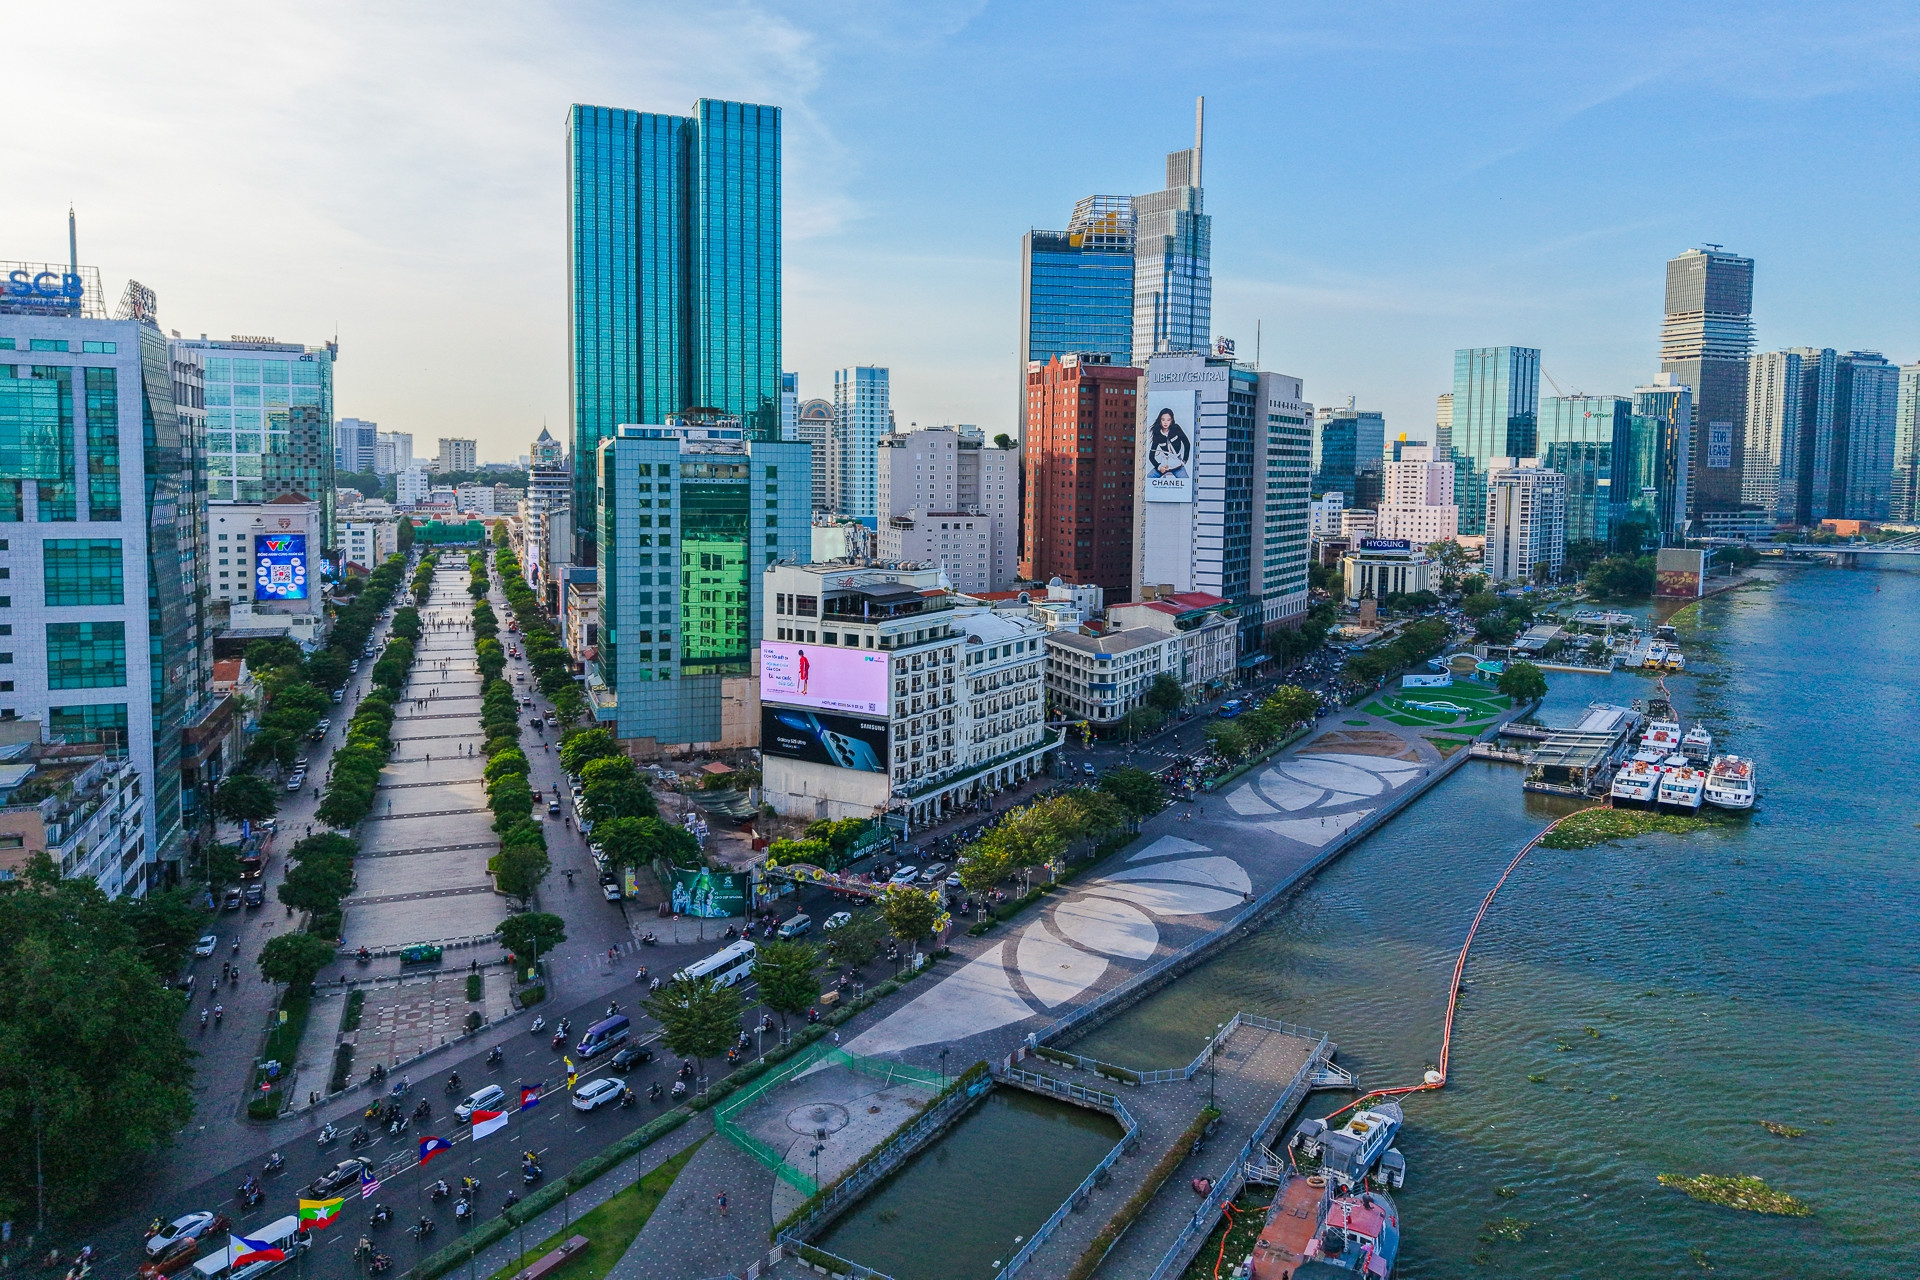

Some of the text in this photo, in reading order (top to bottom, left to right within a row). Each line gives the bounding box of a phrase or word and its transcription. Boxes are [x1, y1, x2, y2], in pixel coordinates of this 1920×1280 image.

[9, 270, 84, 298] SCB
[231, 335, 275, 344] SUNWAH
[299, 353, 313, 362] citi
[1153, 371, 1225, 383] LIBERTY CENTRAL
[1713, 431, 1727, 442] FOR
[1709, 445, 1730, 456] LEASE
[266, 540, 294, 551] VTV
[1366, 540, 1404, 548] HYOSUNG
[860, 723, 886, 731] SAMSUNG
[853, 848, 865, 858] CHO
